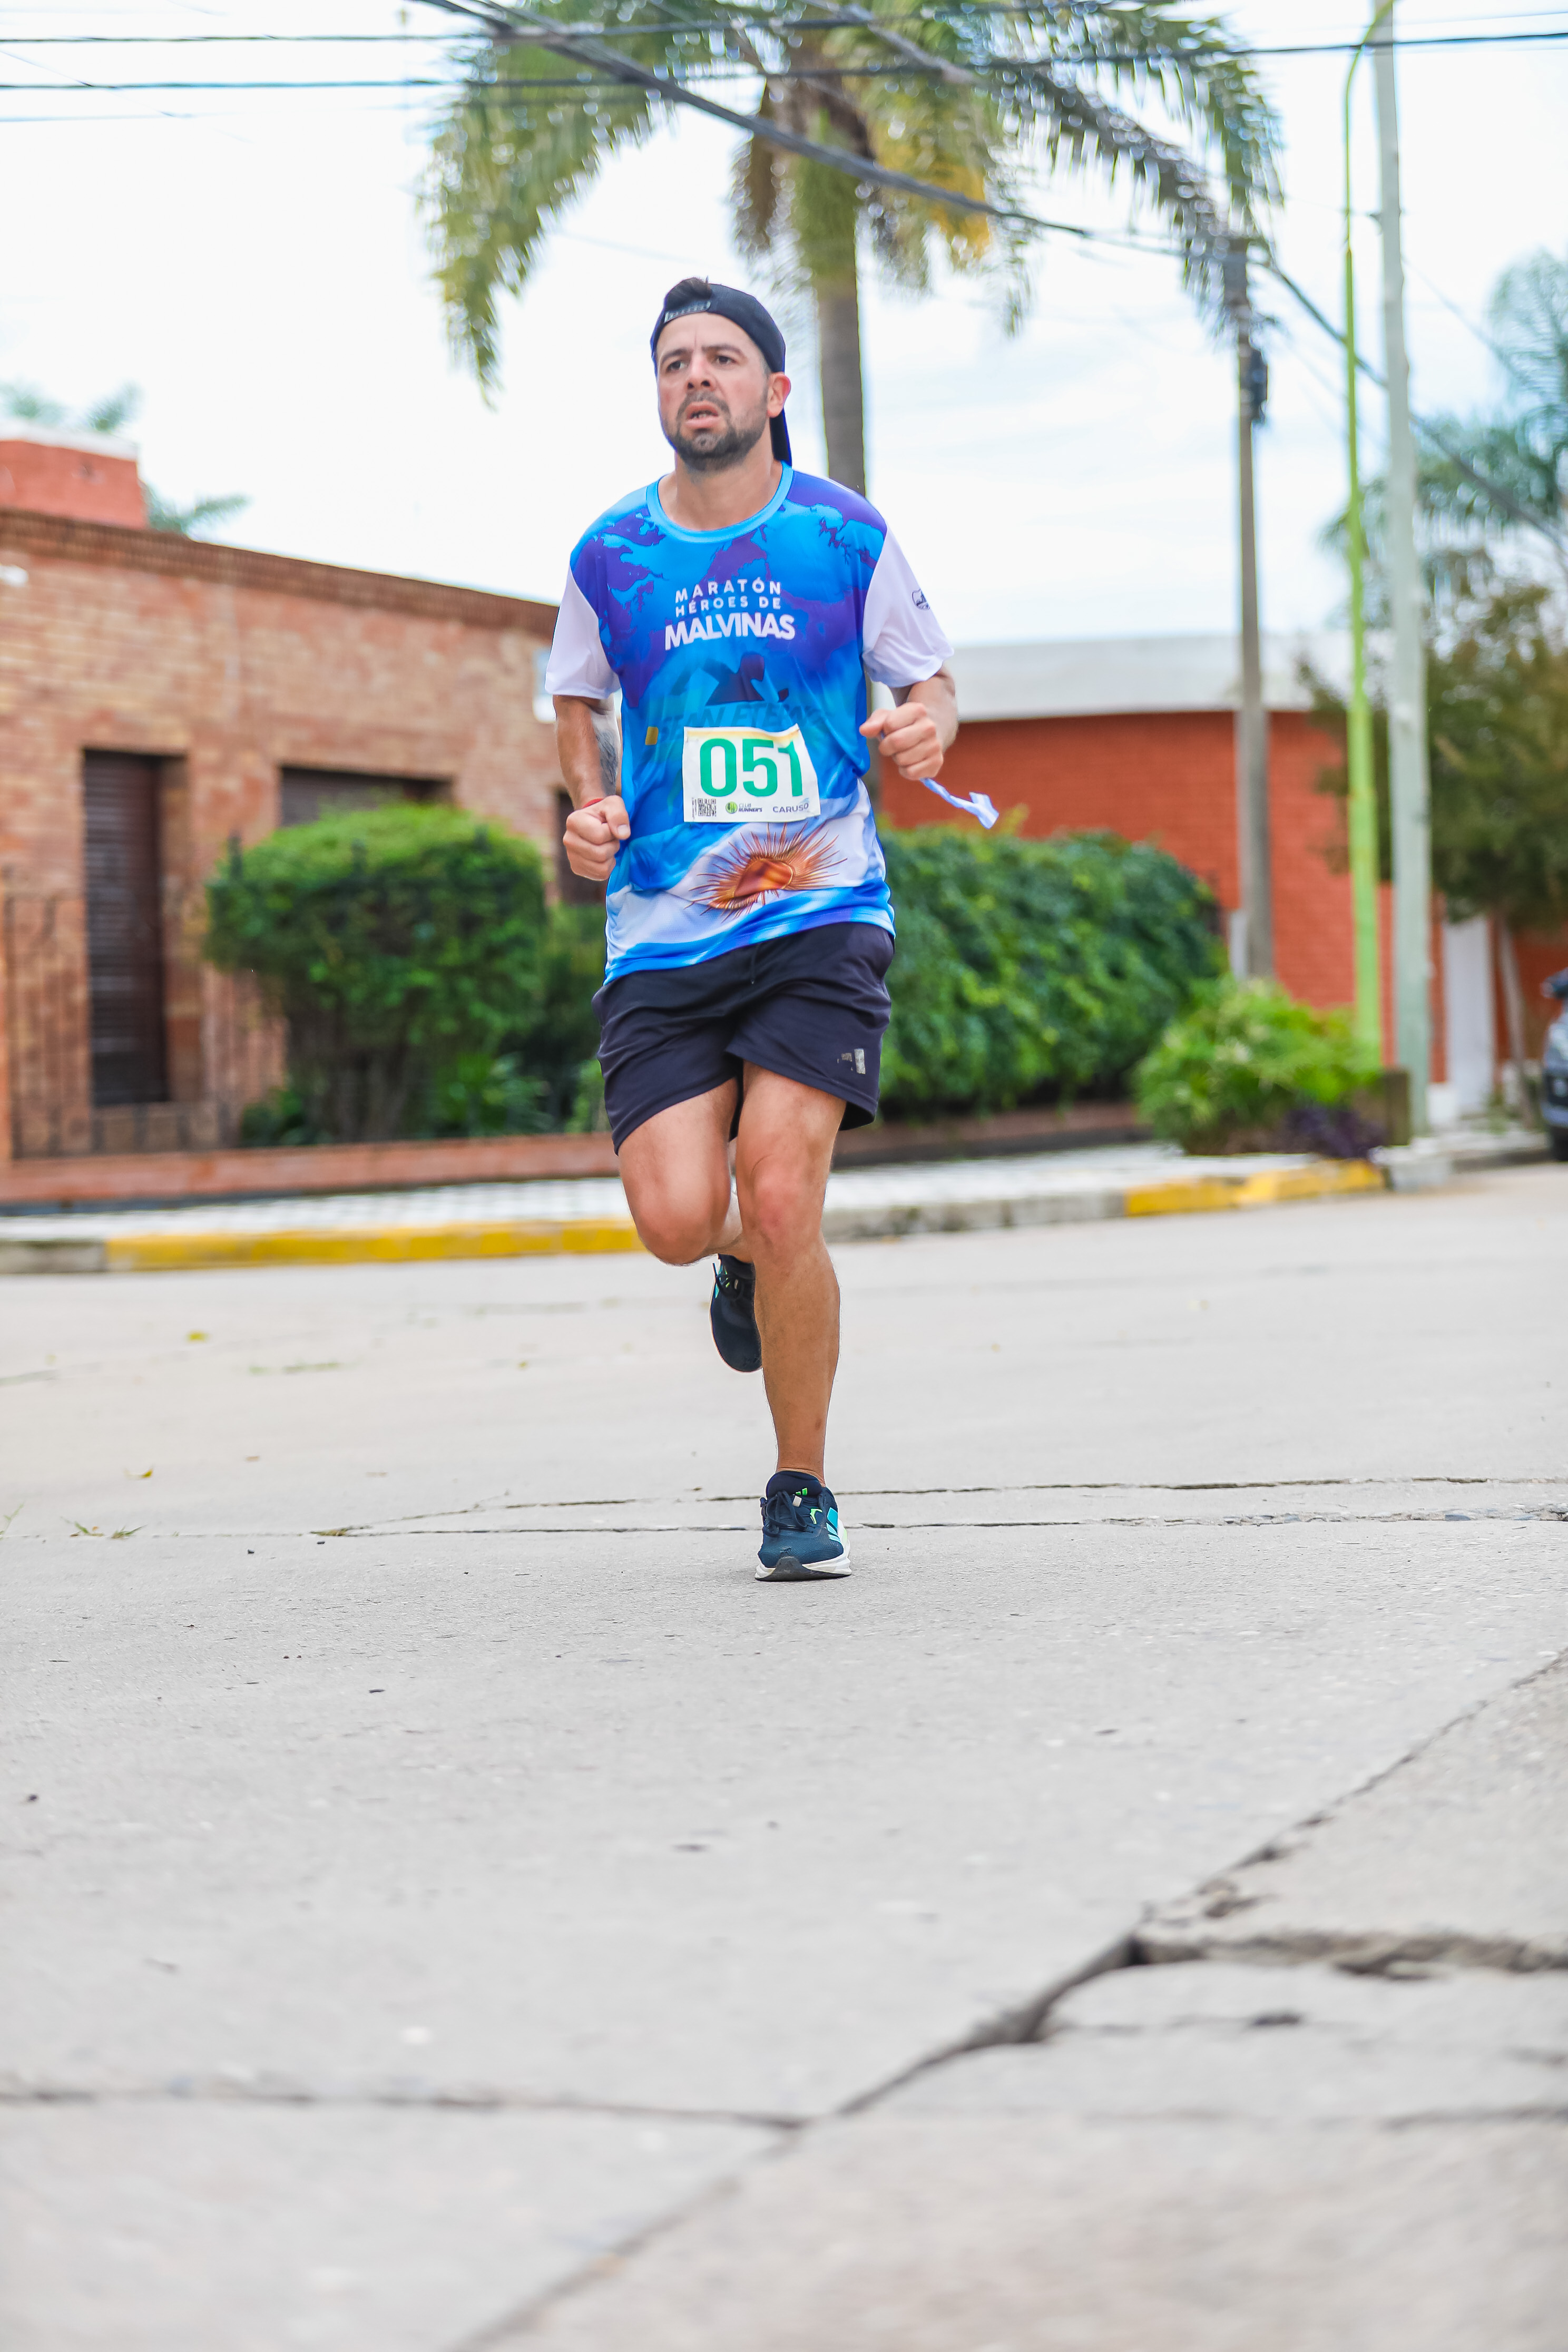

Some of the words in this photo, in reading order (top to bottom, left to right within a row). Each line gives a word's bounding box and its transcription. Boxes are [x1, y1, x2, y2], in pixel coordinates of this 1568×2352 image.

[675, 577, 781, 603] MARATÓN
[759, 596, 781, 609] DE
[664, 612, 796, 650] MALVINAS
[700, 738, 803, 797] 051
[772, 802, 809, 813] CARUSO
